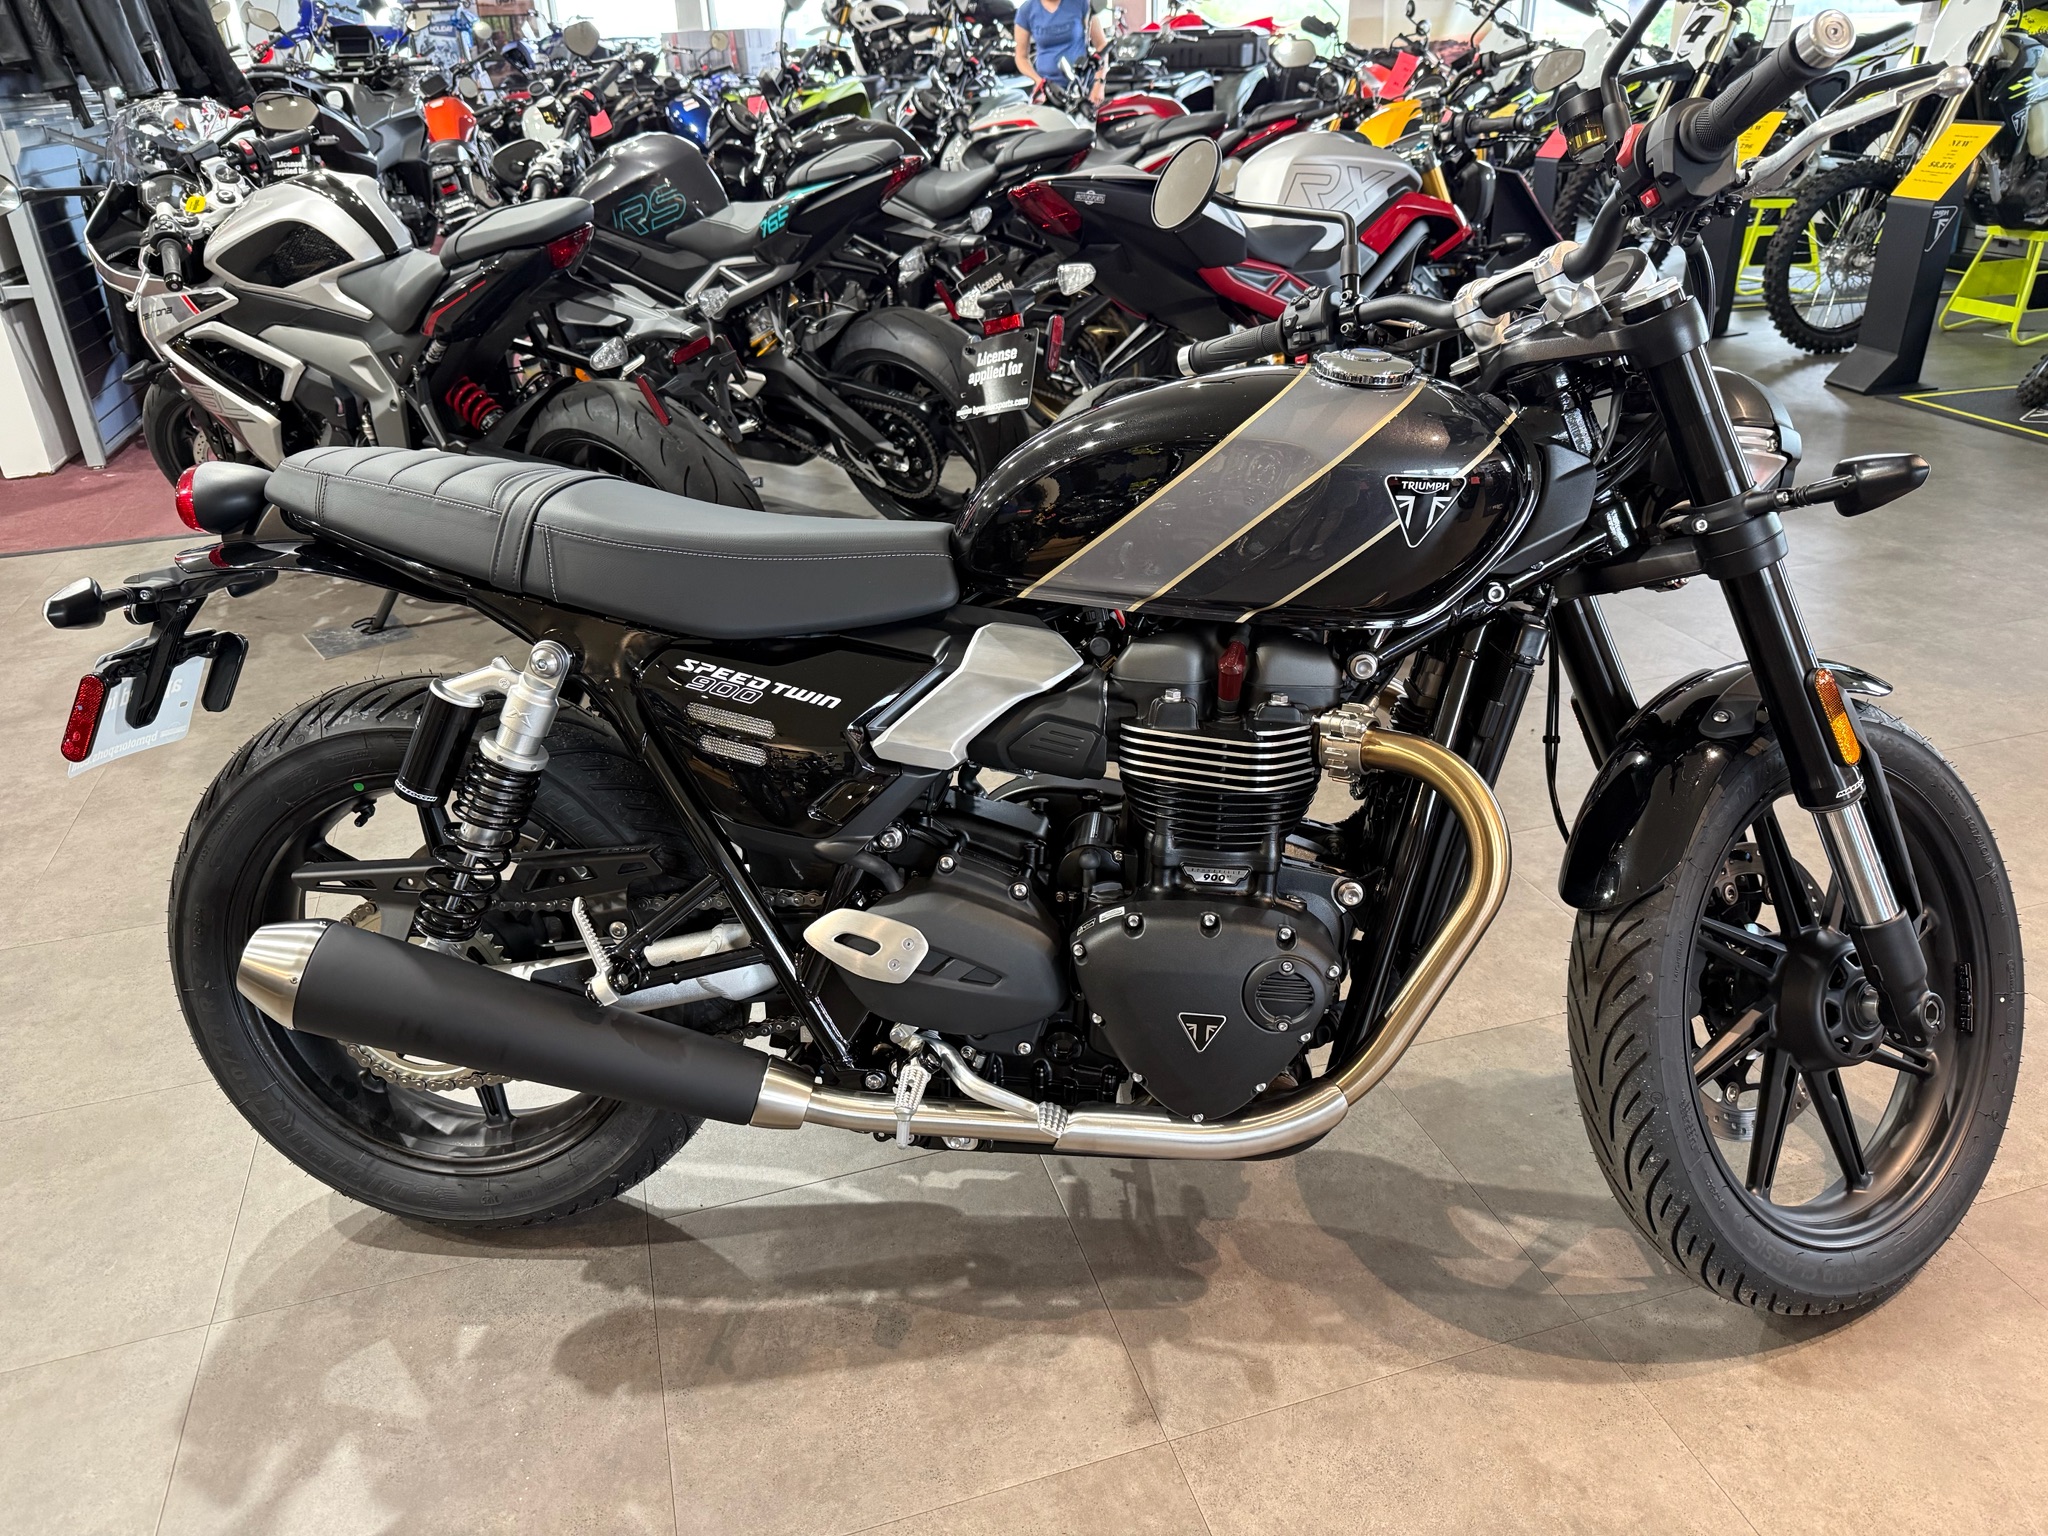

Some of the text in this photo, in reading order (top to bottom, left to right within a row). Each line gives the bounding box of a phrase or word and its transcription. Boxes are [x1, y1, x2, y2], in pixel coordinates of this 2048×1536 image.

[1682, 15, 1715, 43] 4
[1284, 163, 1396, 211] RX
[612, 183, 687, 236] RS
[976, 347, 1018, 367] License
[967, 361, 1023, 386] applied for
[973, 397, 1029, 415] bpmotorsports.com
[1401, 481, 1450, 491] TRIUMPH
[675, 658, 842, 709] SPEED TWIN
[684, 675, 764, 705] 900
[1203, 873, 1226, 882] 900
